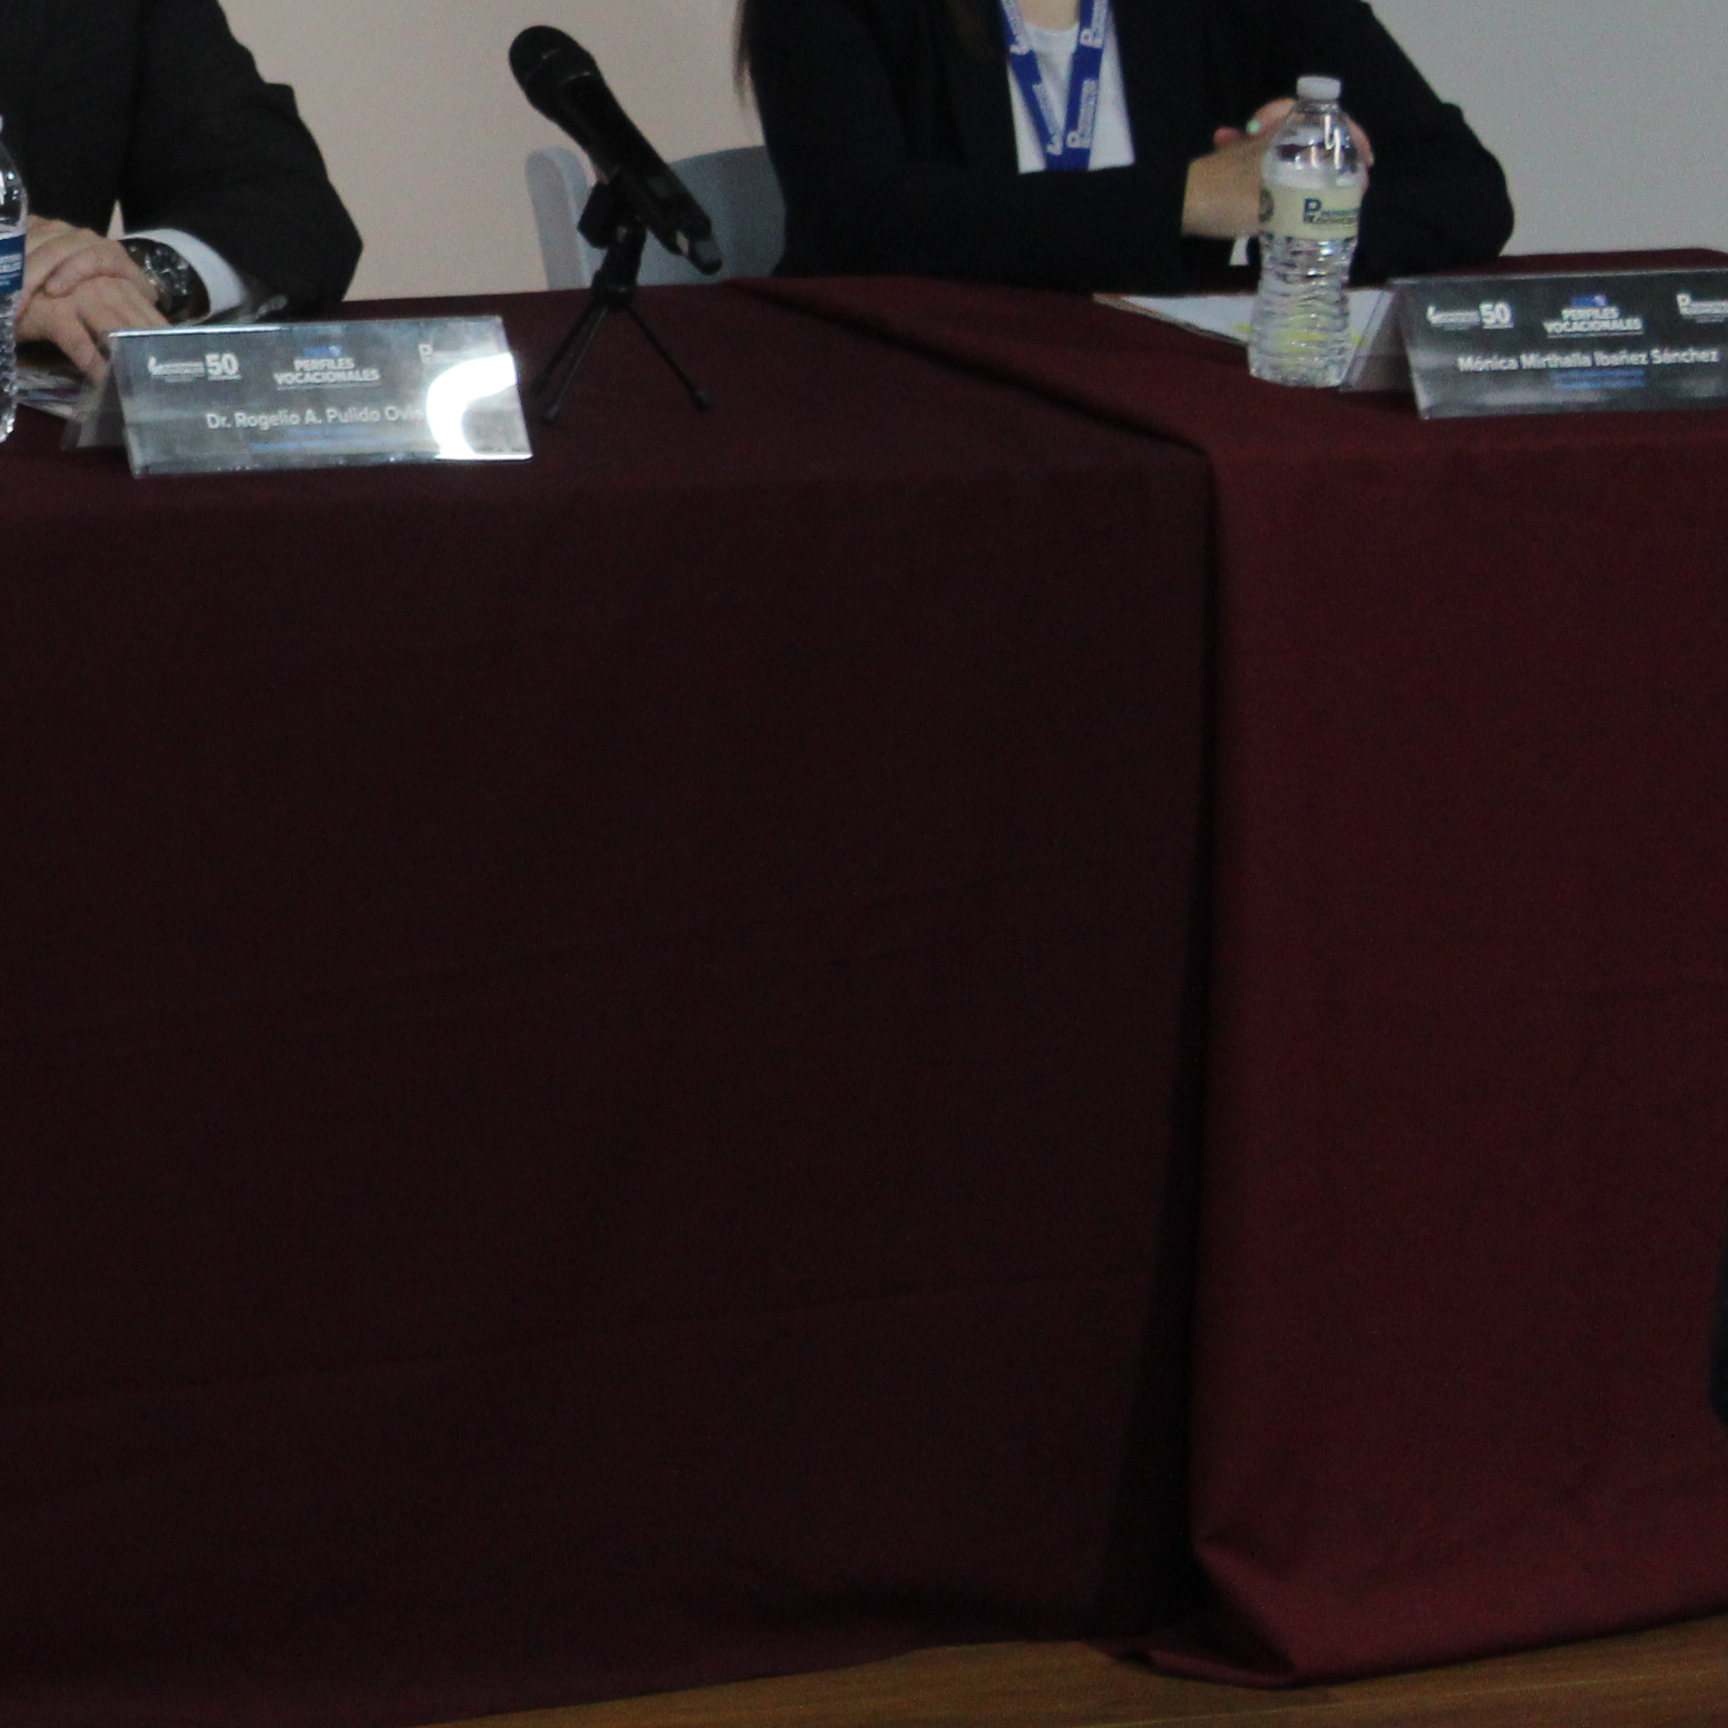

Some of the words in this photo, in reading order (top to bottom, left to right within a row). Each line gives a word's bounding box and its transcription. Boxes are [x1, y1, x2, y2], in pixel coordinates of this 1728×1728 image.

[1479, 300, 1512, 325] 50
[205, 353, 239, 376] 50
[294, 357, 355, 371] PERFILES
[273, 368, 380, 385] VOCACIONALES
[206, 413, 231, 429] Dr.
[235, 410, 300, 430] Rogelio
[305, 409, 322, 424] A.
[326, 406, 380, 423] Pulido
